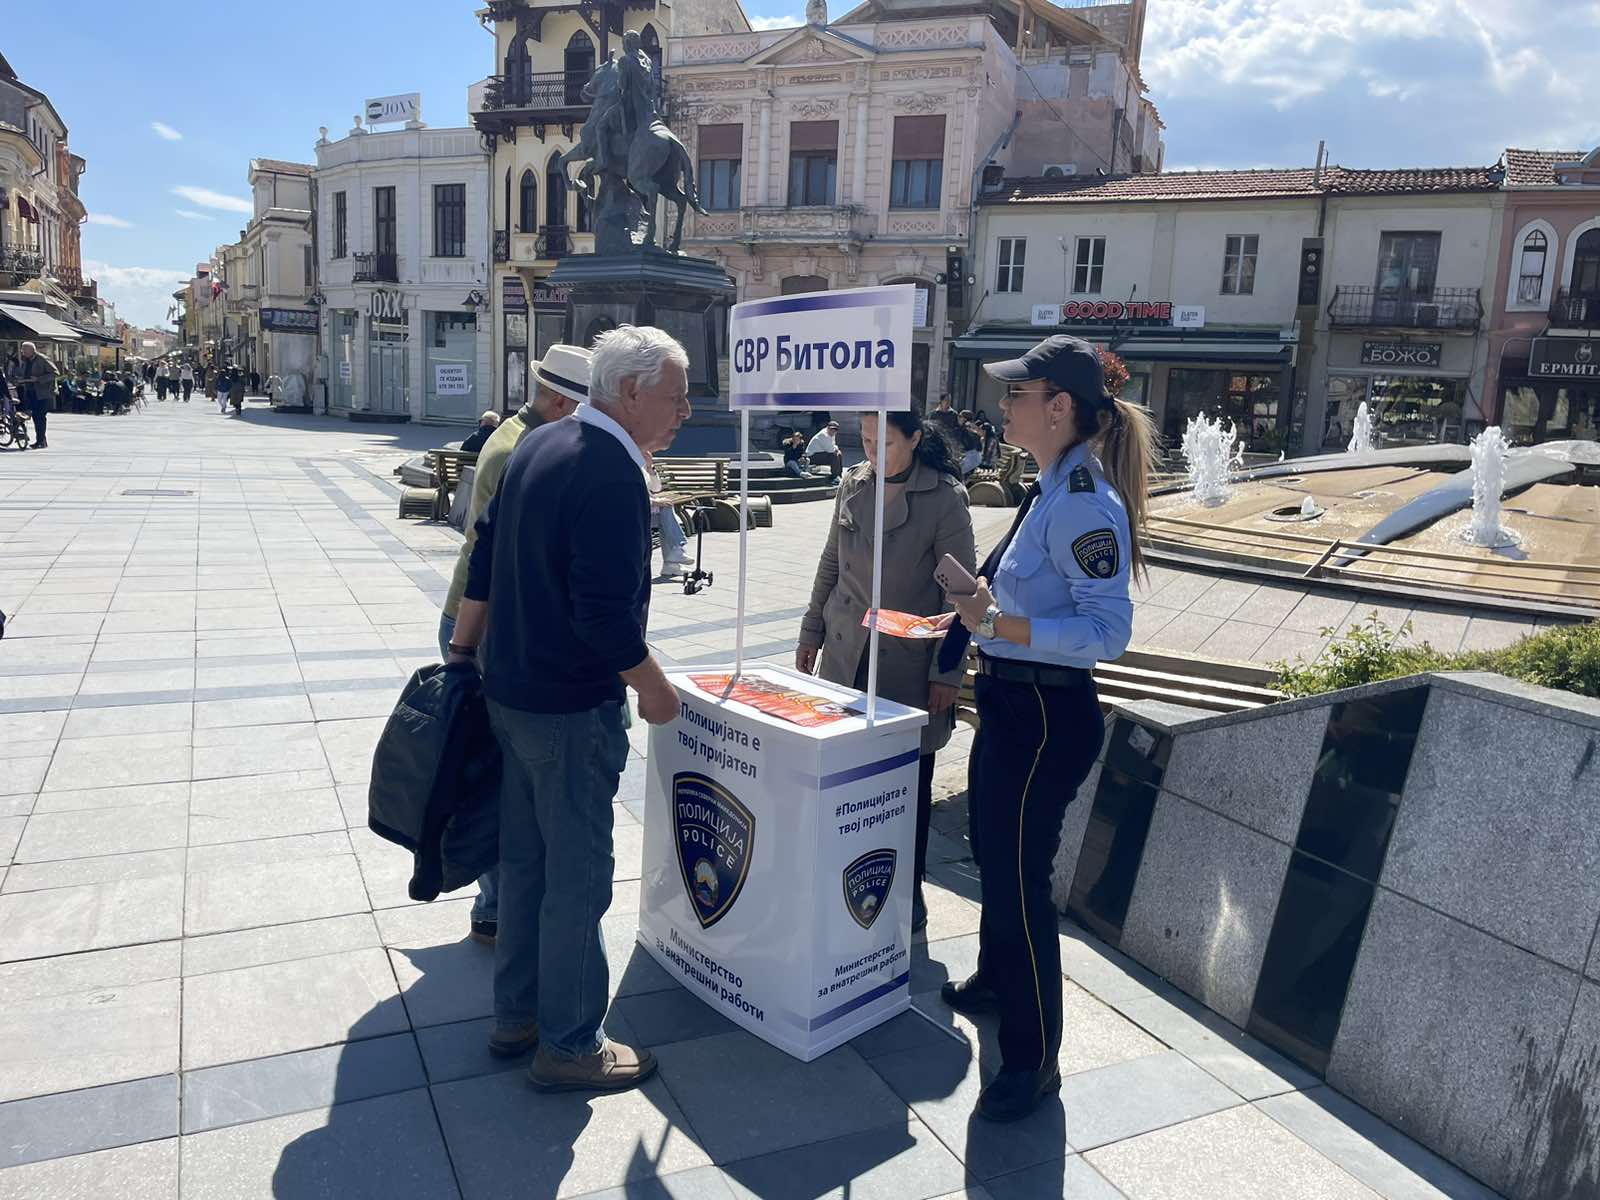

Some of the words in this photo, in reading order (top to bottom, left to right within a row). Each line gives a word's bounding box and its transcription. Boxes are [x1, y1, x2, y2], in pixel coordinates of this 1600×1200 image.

[364, 291, 401, 318] JOXX
[1063, 301, 1124, 319] GOOD
[1125, 302, 1172, 320] TIME
[734, 337, 769, 373] СВР
[776, 335, 895, 371] Битола
[1371, 350, 1430, 363] БОЖО
[1084, 550, 1113, 564] POLICE
[678, 730, 698, 755] твој
[700, 743, 757, 778] пријател
[752, 737, 761, 751] е
[835, 791, 900, 817] #Полицијата
[902, 786, 907, 795] е
[678, 803, 743, 855] ПОЛИЦИЈА
[839, 818, 860, 834] твој
[863, 805, 905, 828] пријател
[683, 829, 735, 869] POLICE
[849, 864, 892, 888] ПОЛИЦИЈА
[852, 878, 887, 897] POLICE
[670, 928, 743, 988] Министерство
[835, 943, 896, 977] Министерство
[656, 937, 665, 953] за
[665, 946, 719, 994] внатрешни
[720, 987, 764, 1022] работи
[817, 987, 829, 998] за
[830, 964, 879, 993] внатрешни
[879, 950, 907, 971] работи
